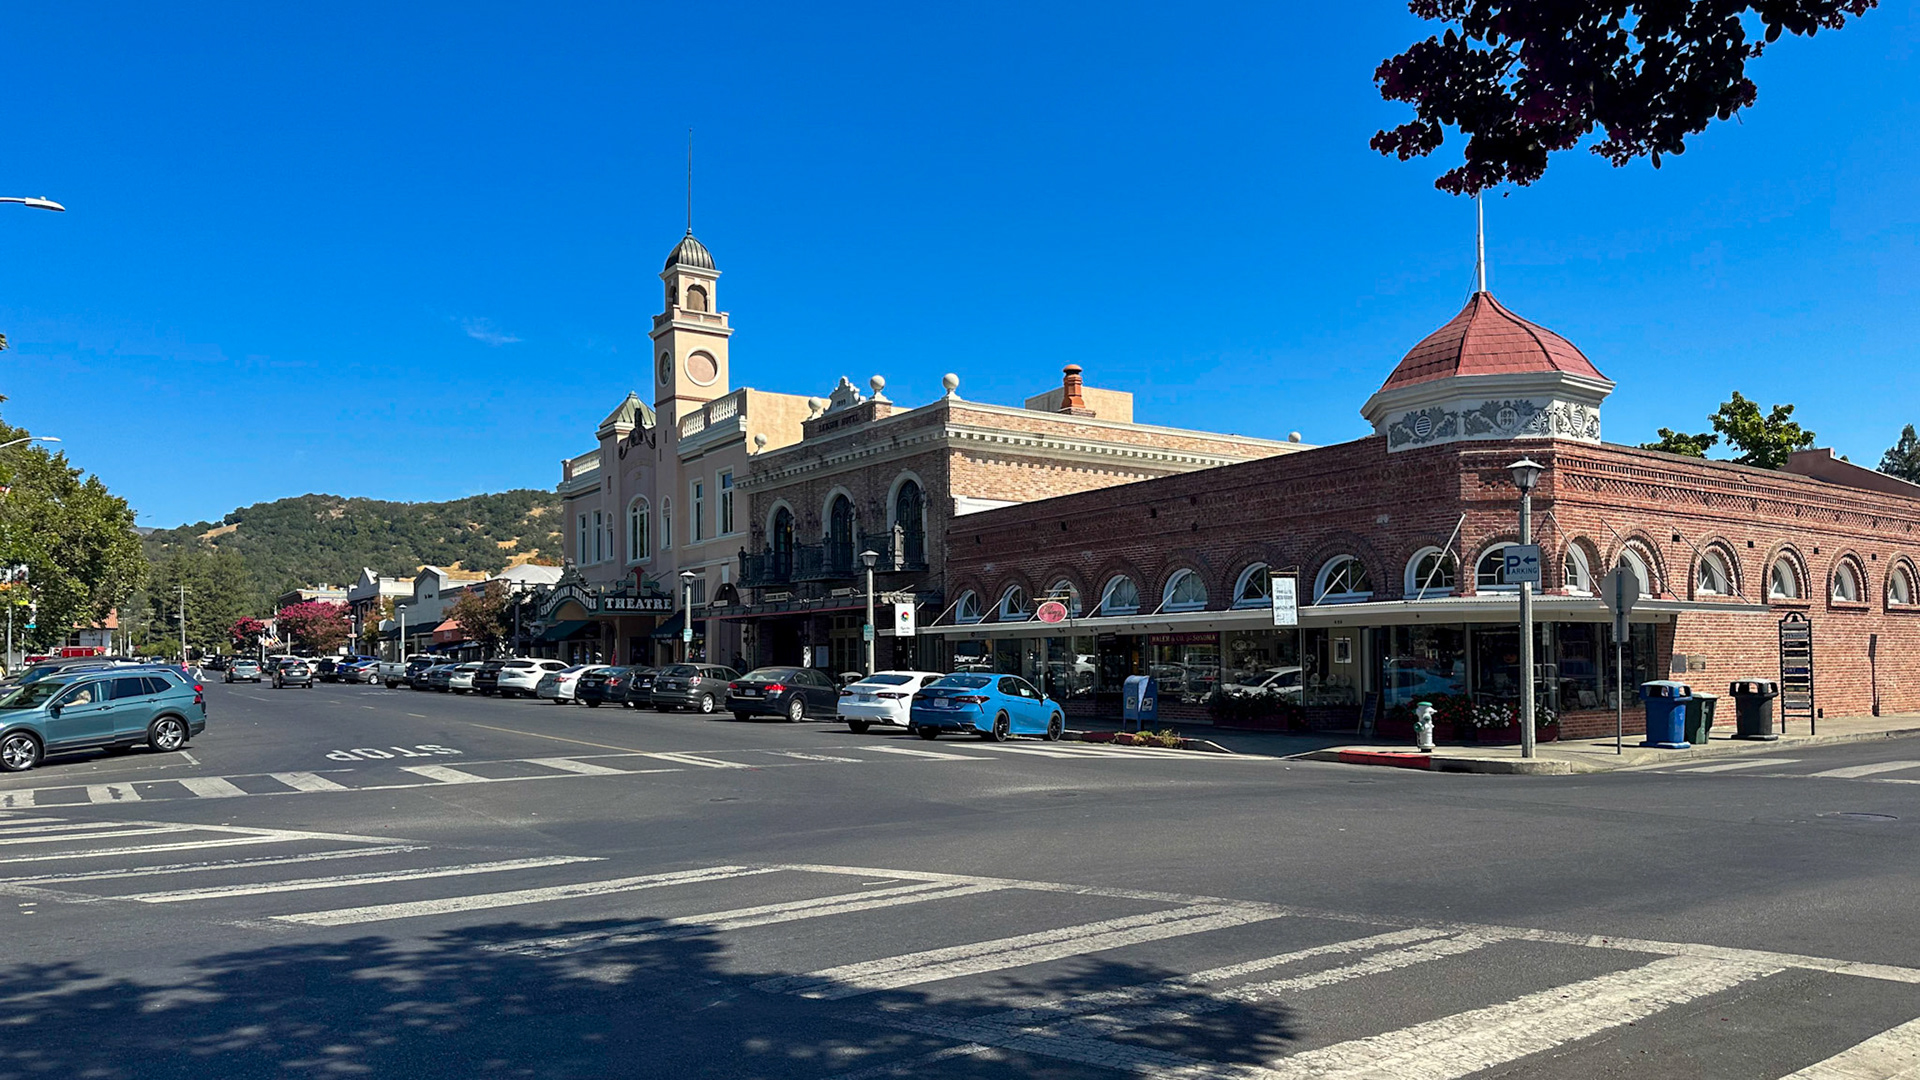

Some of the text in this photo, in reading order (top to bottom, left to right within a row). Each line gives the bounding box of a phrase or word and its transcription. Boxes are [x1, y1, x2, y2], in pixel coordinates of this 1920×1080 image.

[1506, 555, 1537, 575] PARKING
[540, 585, 597, 616] SEBASTIANI THEATRE
[604, 597, 672, 610] THEATRE
[325, 744, 463, 761] STOP
